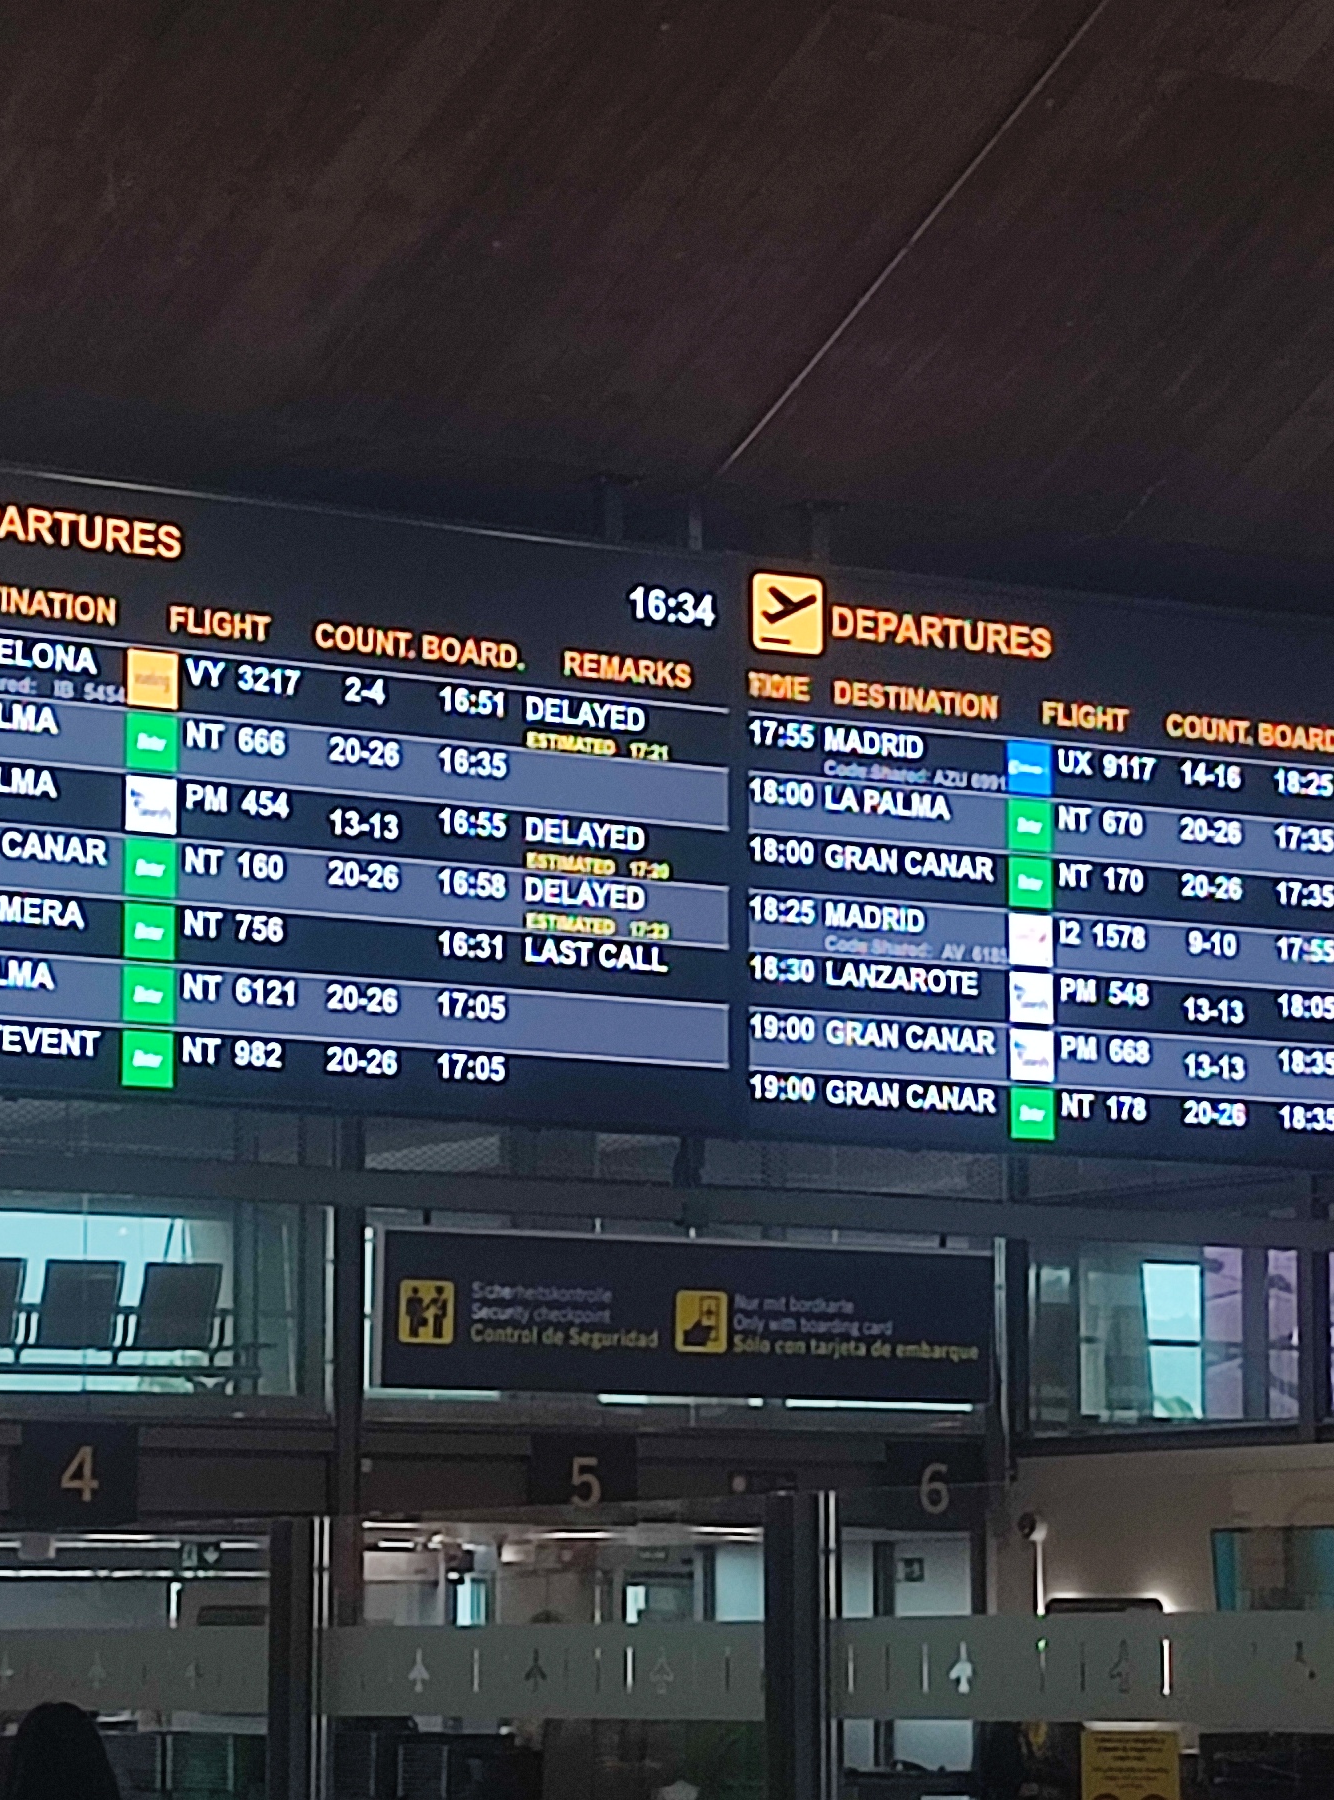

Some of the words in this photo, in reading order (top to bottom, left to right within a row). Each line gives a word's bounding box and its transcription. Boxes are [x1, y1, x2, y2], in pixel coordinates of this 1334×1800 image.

[629, 586, 715, 627] 16:34
[831, 605, 1052, 658] DEPARTURES
[170, 606, 271, 641] FLIGHT
[315, 623, 417, 660] COUNT.
[422, 634, 524, 669] BOARD.
[564, 651, 692, 688] REMARKS
[185, 657, 226, 688] VY
[237, 664, 301, 696] 3217
[344, 676, 386, 705] 2-4
[439, 686, 504, 717] 16:51
[525, 695, 645, 732] DELAYED
[834, 680, 998, 719] DESTINATION
[1042, 701, 1129, 731] FLIGHT
[749, 719, 815, 749] 17:55
[824, 726, 924, 759] MADRID
[1057, 748, 1093, 776] UX
[1102, 753, 1157, 781] 9117
[1180, 760, 1242, 789] 14-16
[1273, 768, 1334, 797] 18:25
[1, 831, 108, 866] CANAR
[184, 846, 225, 876] NT
[237, 851, 284, 881] 160
[328, 859, 399, 891] 20-26
[438, 868, 506, 899] 16:58
[524, 876, 645, 911] DELAYED
[182, 1035, 222, 1064] NT
[234, 1039, 282, 1068] 982
[326, 1045, 398, 1076] 20-26
[437, 1052, 506, 1082] 17:05
[749, 1073, 816, 1101] 19:00
[825, 1079, 900, 1108] GRAN
[906, 1083, 997, 1114] CANAR
[1061, 1091, 1095, 1118] NT
[1106, 1095, 1147, 1121] 178
[1183, 1099, 1247, 1127] 20-26
[471, 1323, 538, 1344] Control
[542, 1326, 565, 1346] de
[569, 1327, 659, 1349] Seguridad
[775, 1340, 807, 1355] con
[810, 1337, 867, 1359] tarjeta
[870, 1339, 893, 1358] de
[896, 1340, 980, 1363] embarque
[60, 1445, 100, 1502] 4
[570, 1456, 602, 1505] 5
[919, 1462, 951, 1514] 6
